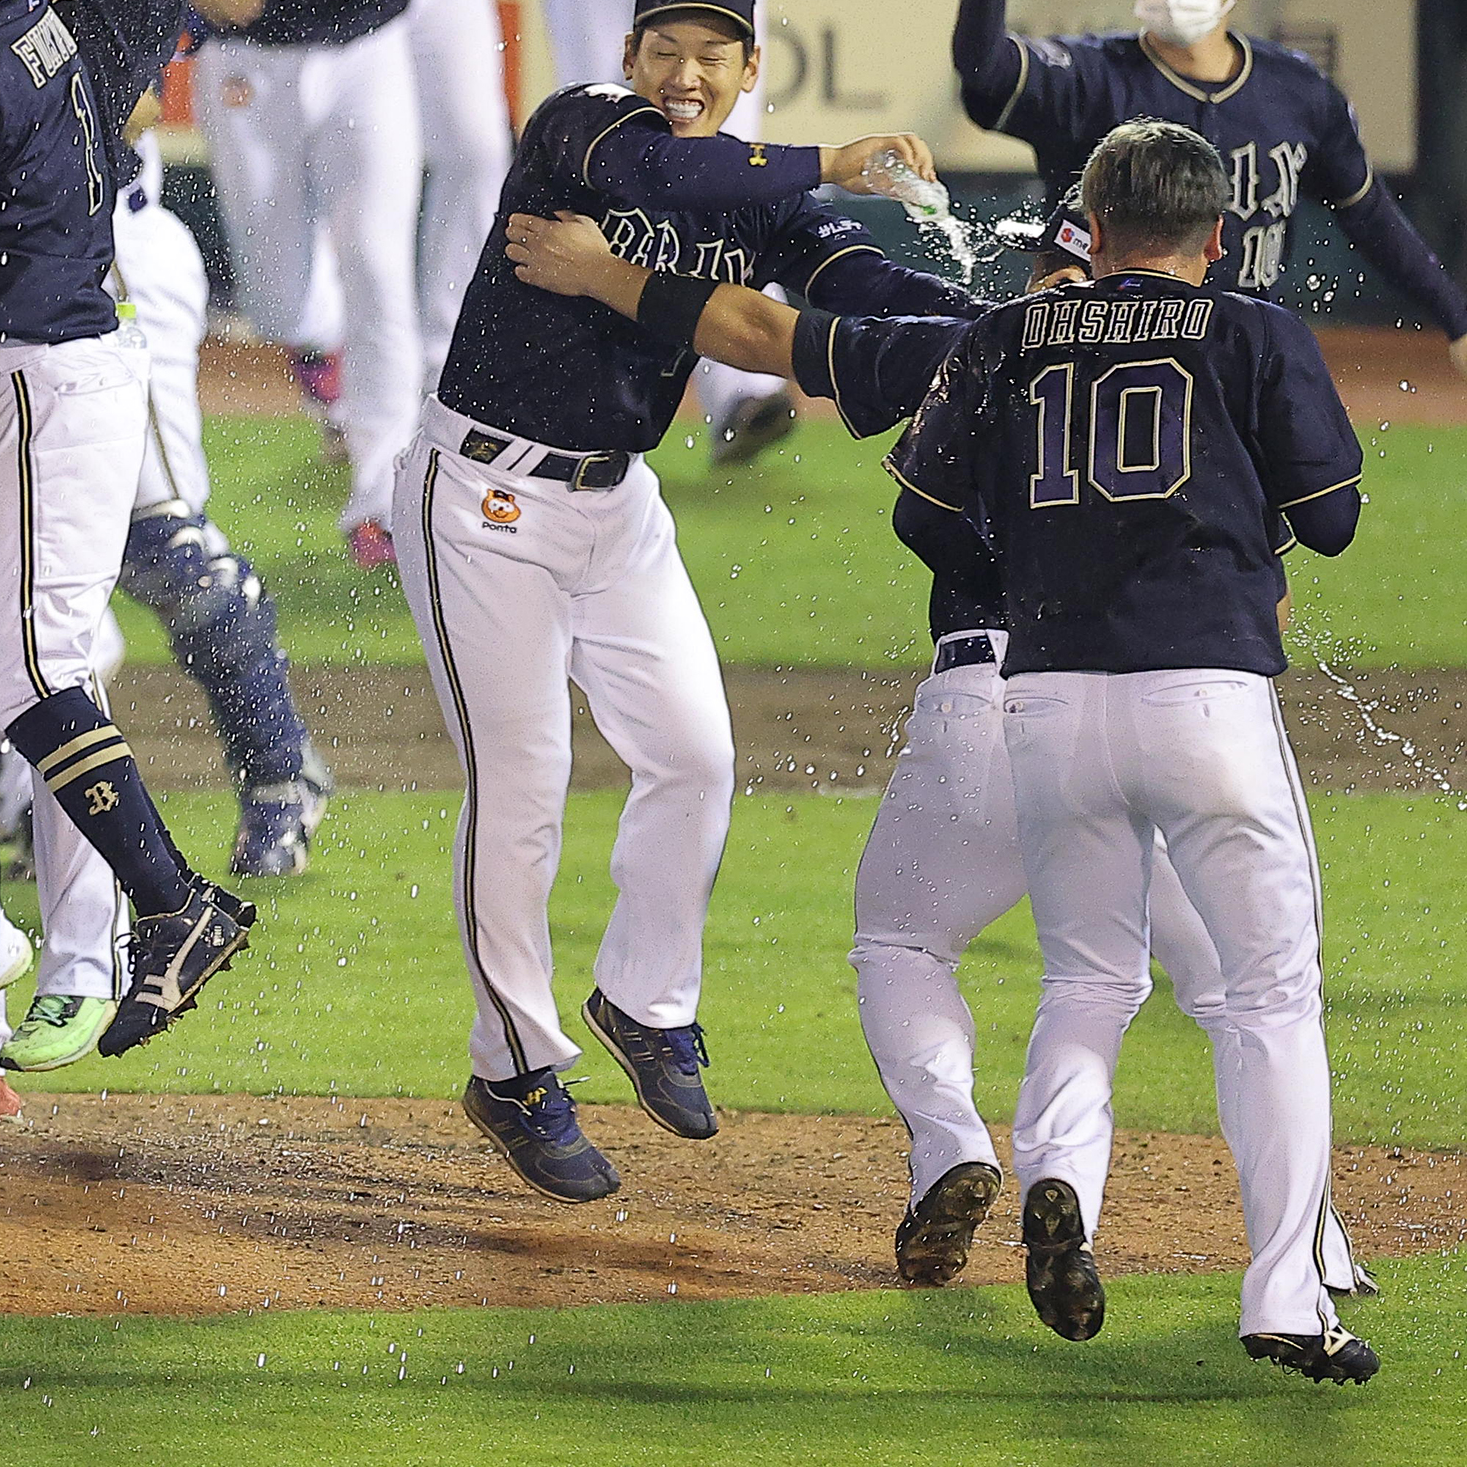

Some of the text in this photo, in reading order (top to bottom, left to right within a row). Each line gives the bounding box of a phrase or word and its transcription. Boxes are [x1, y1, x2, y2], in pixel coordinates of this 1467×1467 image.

[1020, 297, 1215, 351] OHSHIRO
[1028, 355, 1195, 510] 10
[480, 520, 519, 535] Ponta
[84, 780, 121, 818] B
